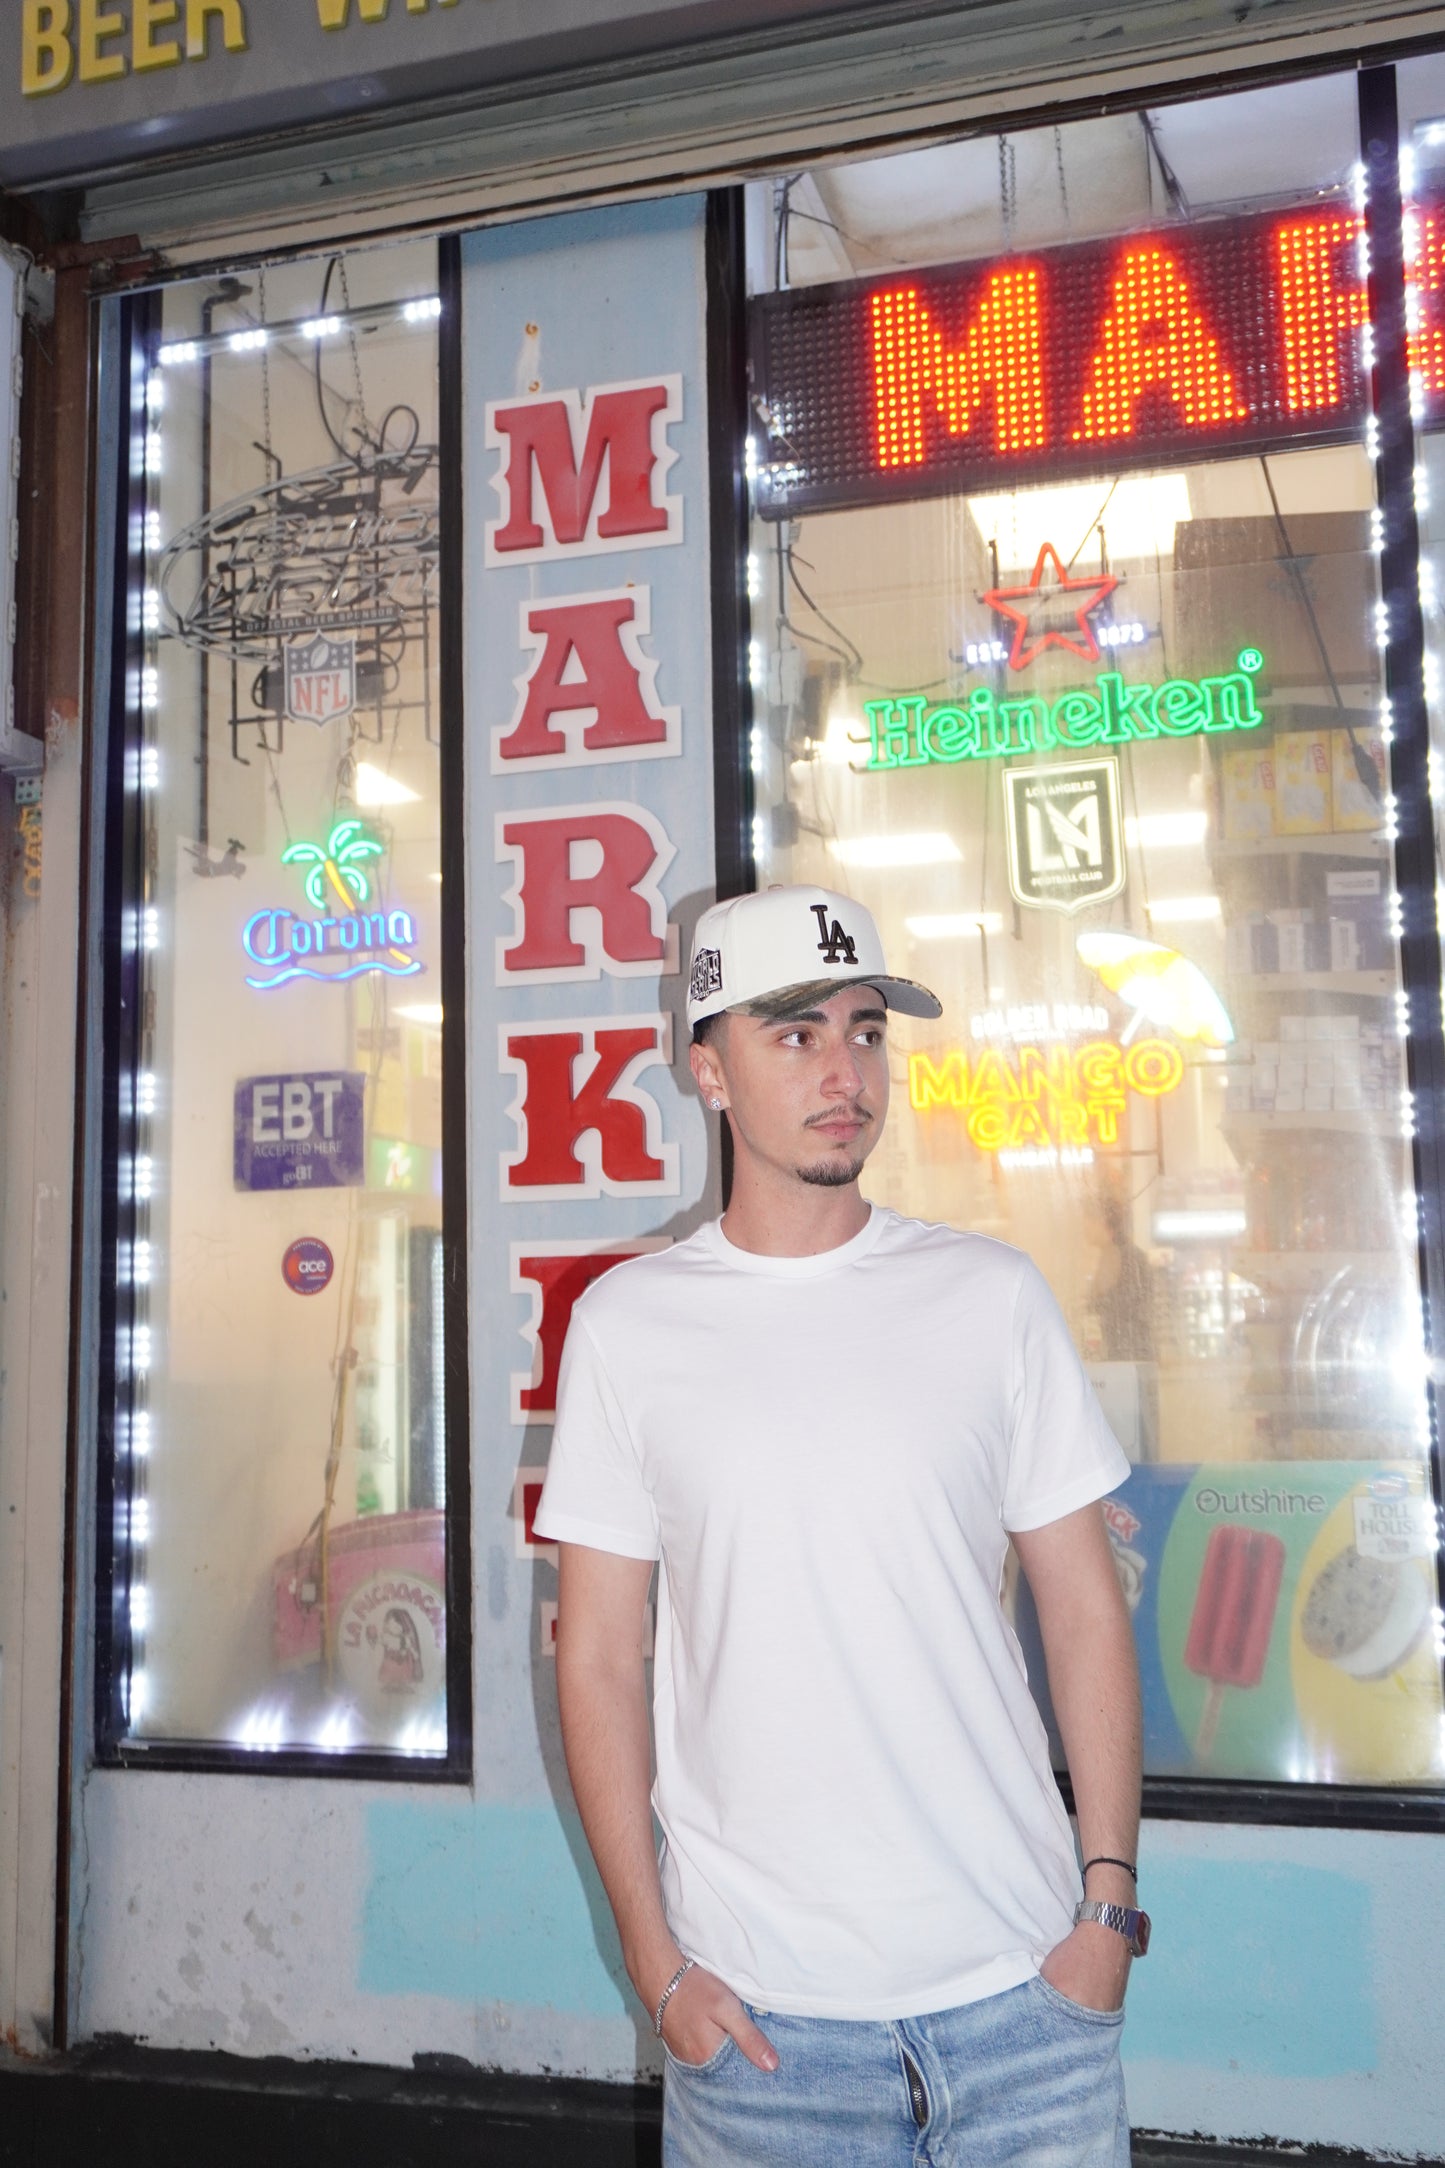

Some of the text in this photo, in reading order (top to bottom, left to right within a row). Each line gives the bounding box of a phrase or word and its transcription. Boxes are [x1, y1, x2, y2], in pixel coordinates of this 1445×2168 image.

[293, 673, 348, 717] NFL
[1048, 780, 1097, 795] ANGELES
[1031, 871, 1104, 887] FOOTBALL CLUB
[243, 909, 413, 966] Corona
[810, 904, 858, 964] LA
[908, 1038, 1183, 1109] MANGO
[252, 1080, 343, 1142] EBT
[967, 1097, 1126, 1150] CART
[253, 1140, 343, 1158] ACCEPTED HERE
[298, 1260, 327, 1273] ace
[1196, 1488, 1325, 1514] Outshine
[1368, 1503, 1411, 1518] TOLL
